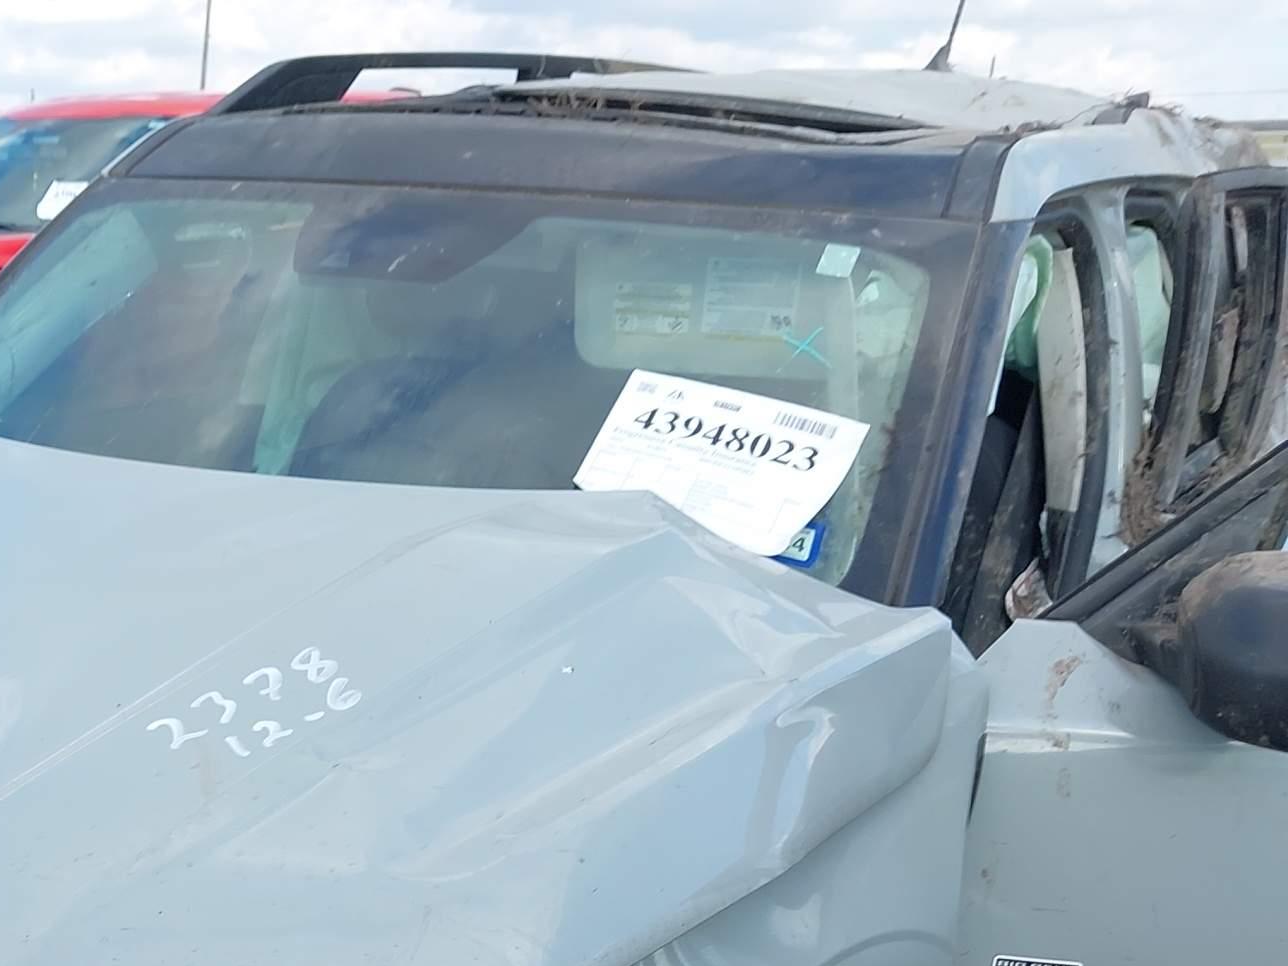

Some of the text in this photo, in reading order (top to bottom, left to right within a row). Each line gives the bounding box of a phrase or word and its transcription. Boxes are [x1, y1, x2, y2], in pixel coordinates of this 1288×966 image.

[634, 406, 819, 471] 43948023
[145, 645, 339, 750] 2378
[224, 676, 362, 758] 12-6
